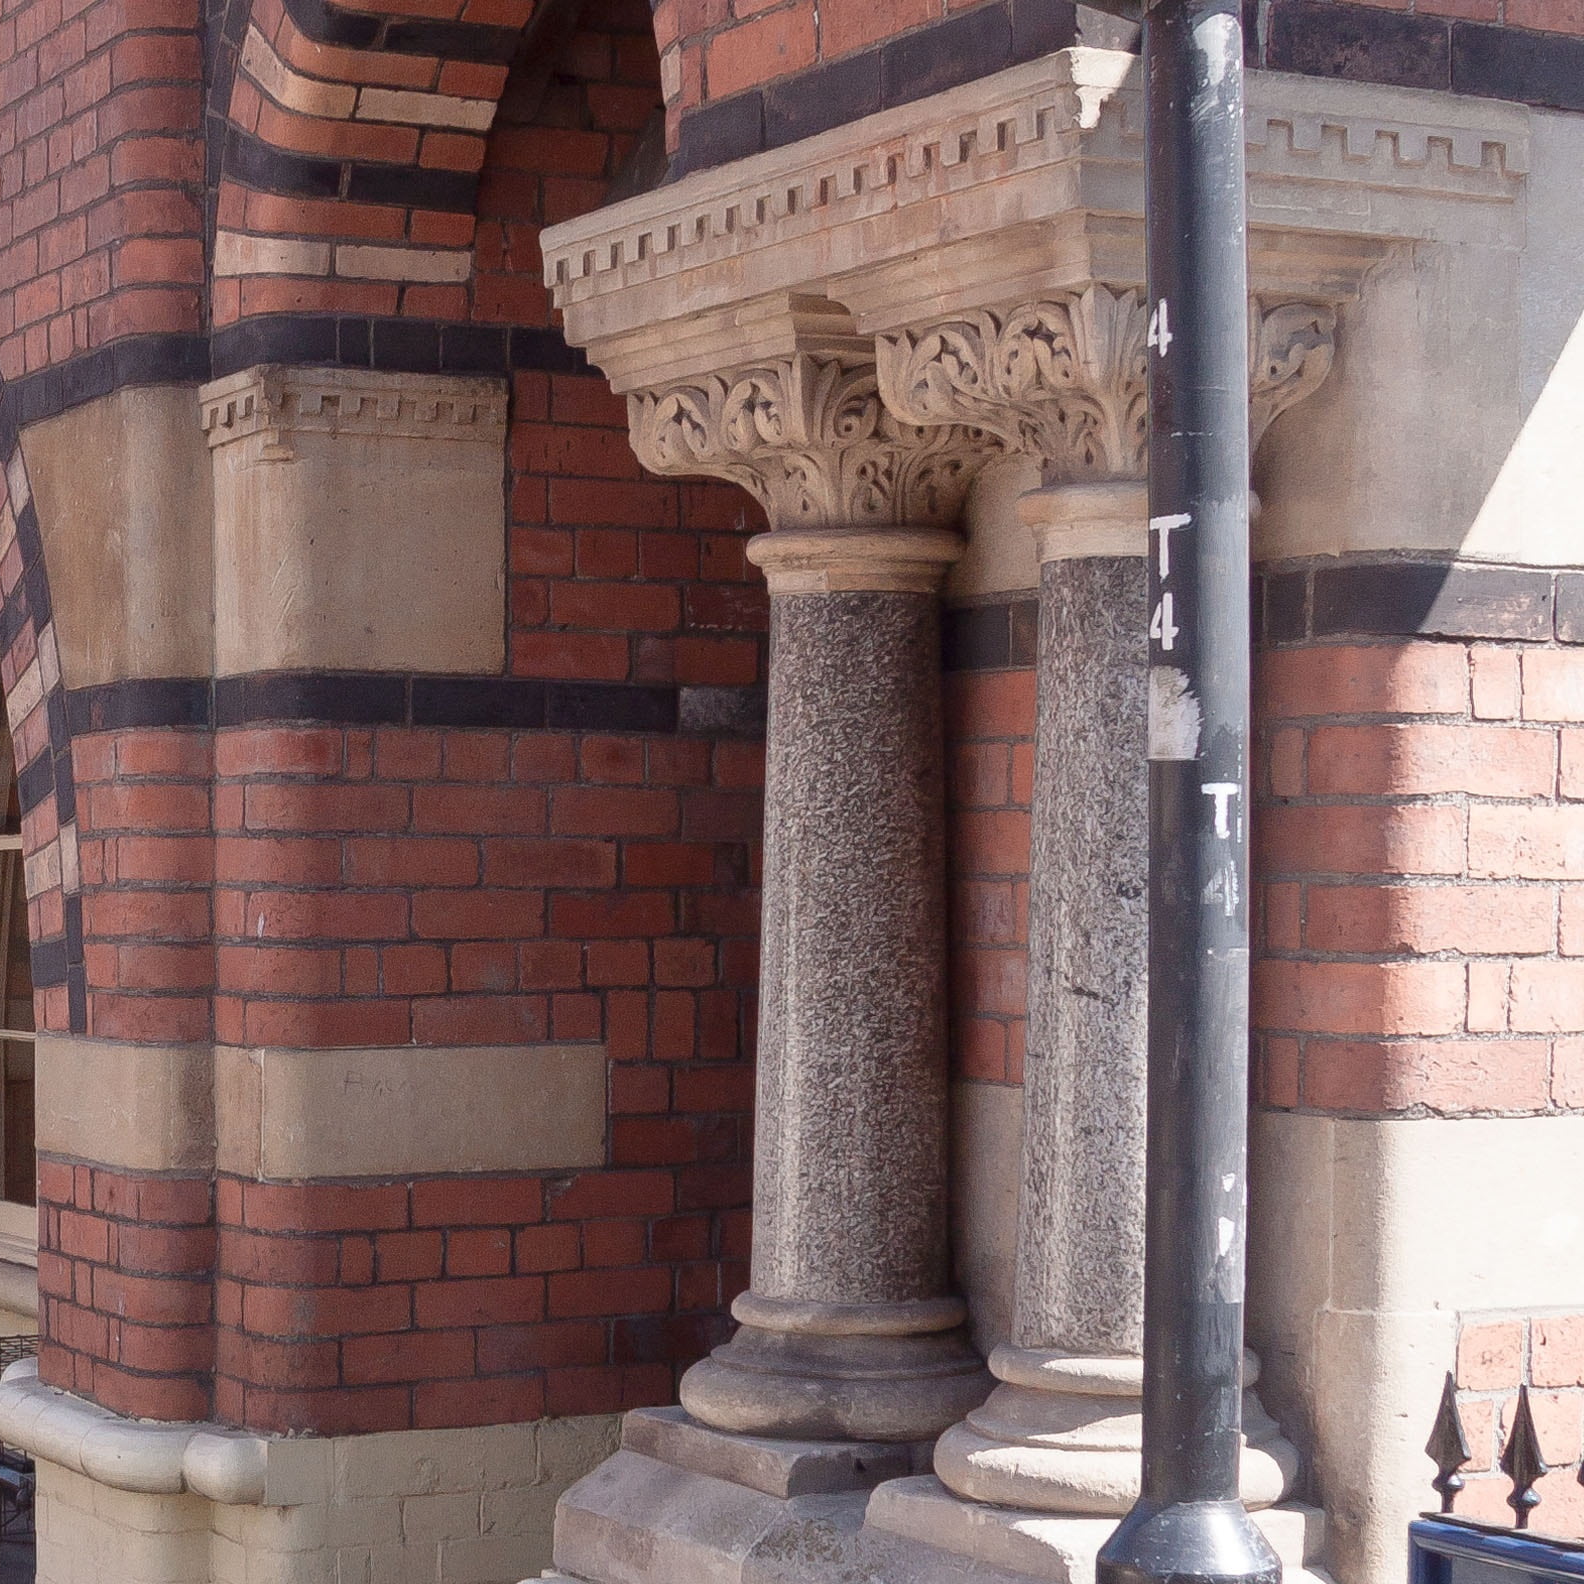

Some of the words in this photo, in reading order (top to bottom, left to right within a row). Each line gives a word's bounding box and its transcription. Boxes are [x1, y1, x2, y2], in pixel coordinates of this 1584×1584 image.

[1147, 297, 1174, 358] 4
[1149, 513, 1192, 579] T
[1149, 592, 1179, 651] 4
[1200, 782, 1239, 840] T
